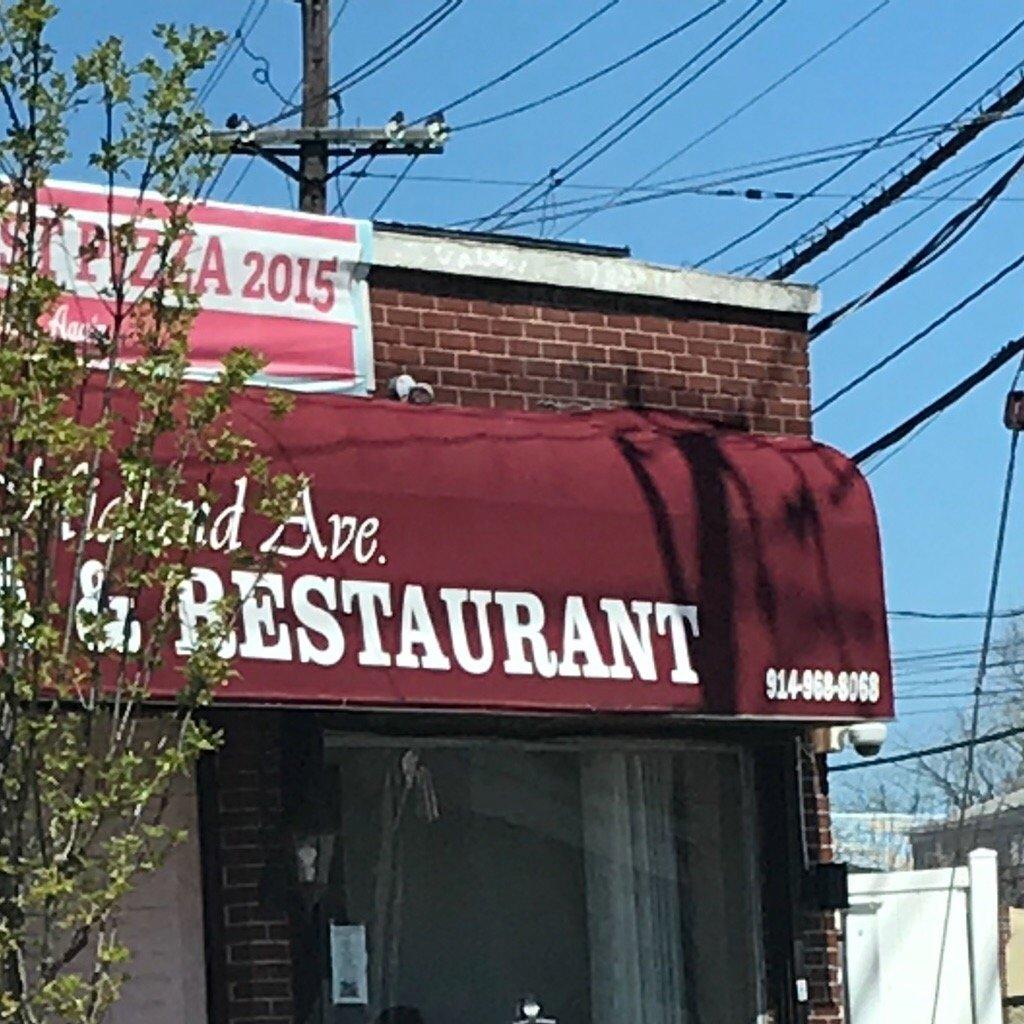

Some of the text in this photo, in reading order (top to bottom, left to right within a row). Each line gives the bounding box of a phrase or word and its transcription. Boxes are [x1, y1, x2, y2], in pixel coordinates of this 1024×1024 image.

[242, 250, 339, 313] 2015
[259, 480, 386, 565] Ave.
[76, 559, 142, 653] &
[176, 566, 698, 684] RESTAURANT
